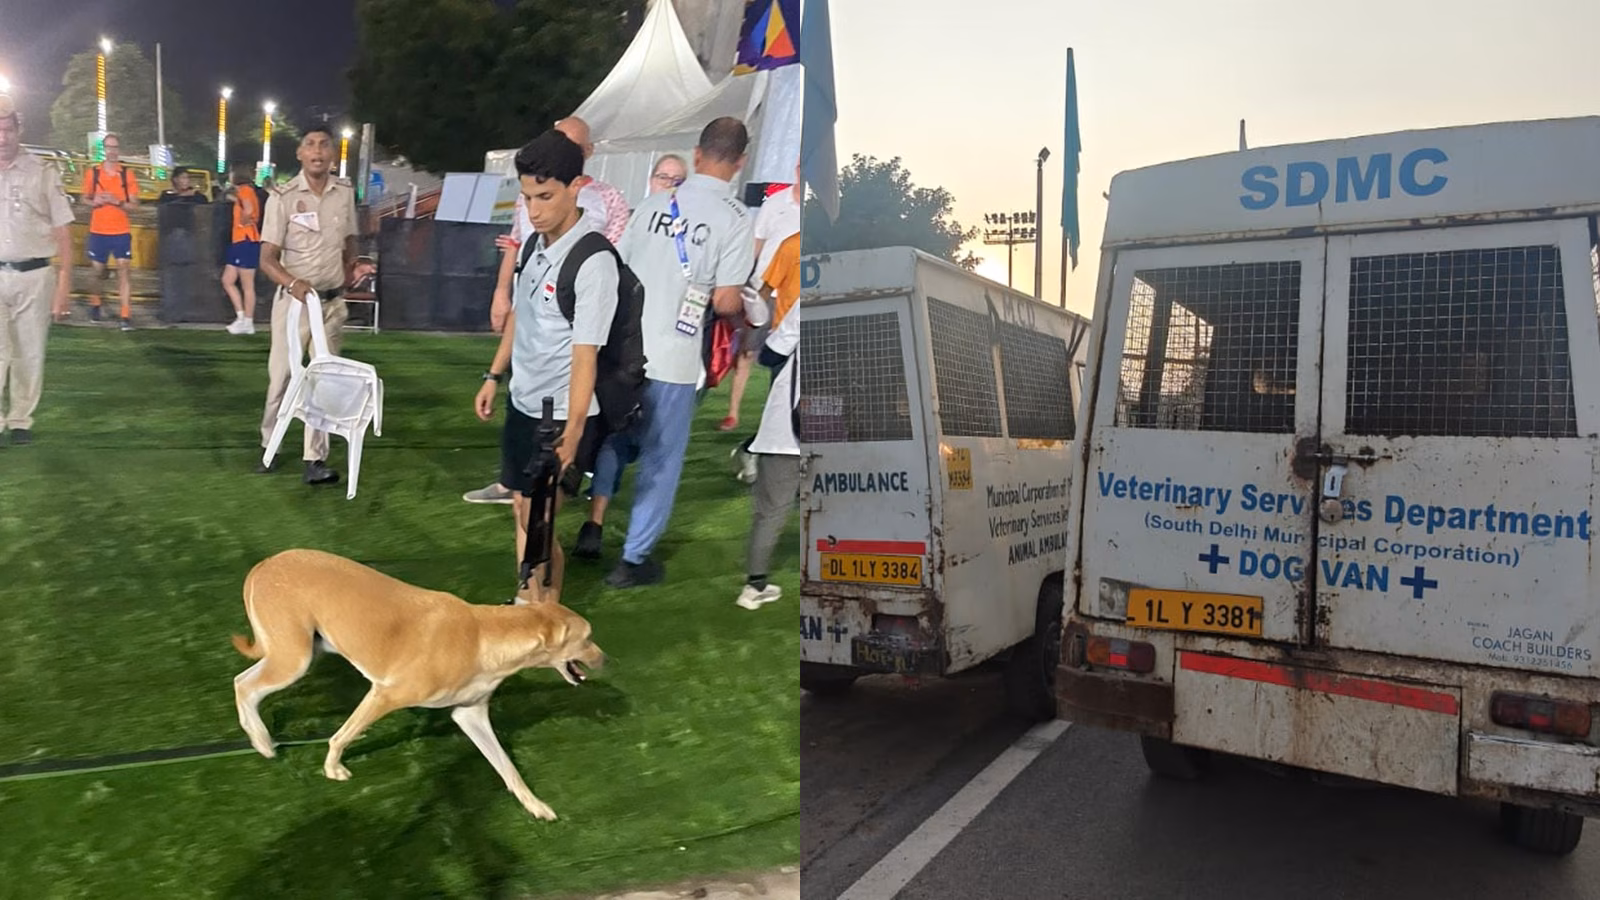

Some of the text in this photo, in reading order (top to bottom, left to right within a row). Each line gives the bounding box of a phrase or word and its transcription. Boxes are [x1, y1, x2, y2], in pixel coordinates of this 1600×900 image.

[1240, 148, 1449, 210] SDMC
[812, 471, 909, 493] AMBULANCE
[987, 481, 1020, 508] Municipal
[1098, 470, 1232, 515] Veterinary
[1241, 483, 1372, 522] Serves
[1384, 495, 1591, 541] Department
[1145, 511, 1520, 568] (South Delhi Muncipal Corporation)
[1008, 541, 1038, 566] ANIMAL
[830, 559, 918, 580] DL 1LY 3384
[1239, 550, 1389, 592] DOG VAN
[1146, 600, 1255, 629] 1L Y 3381
[1508, 626, 1553, 642] JAGAN
[1472, 636, 1592, 661] COACH BUILDERS
